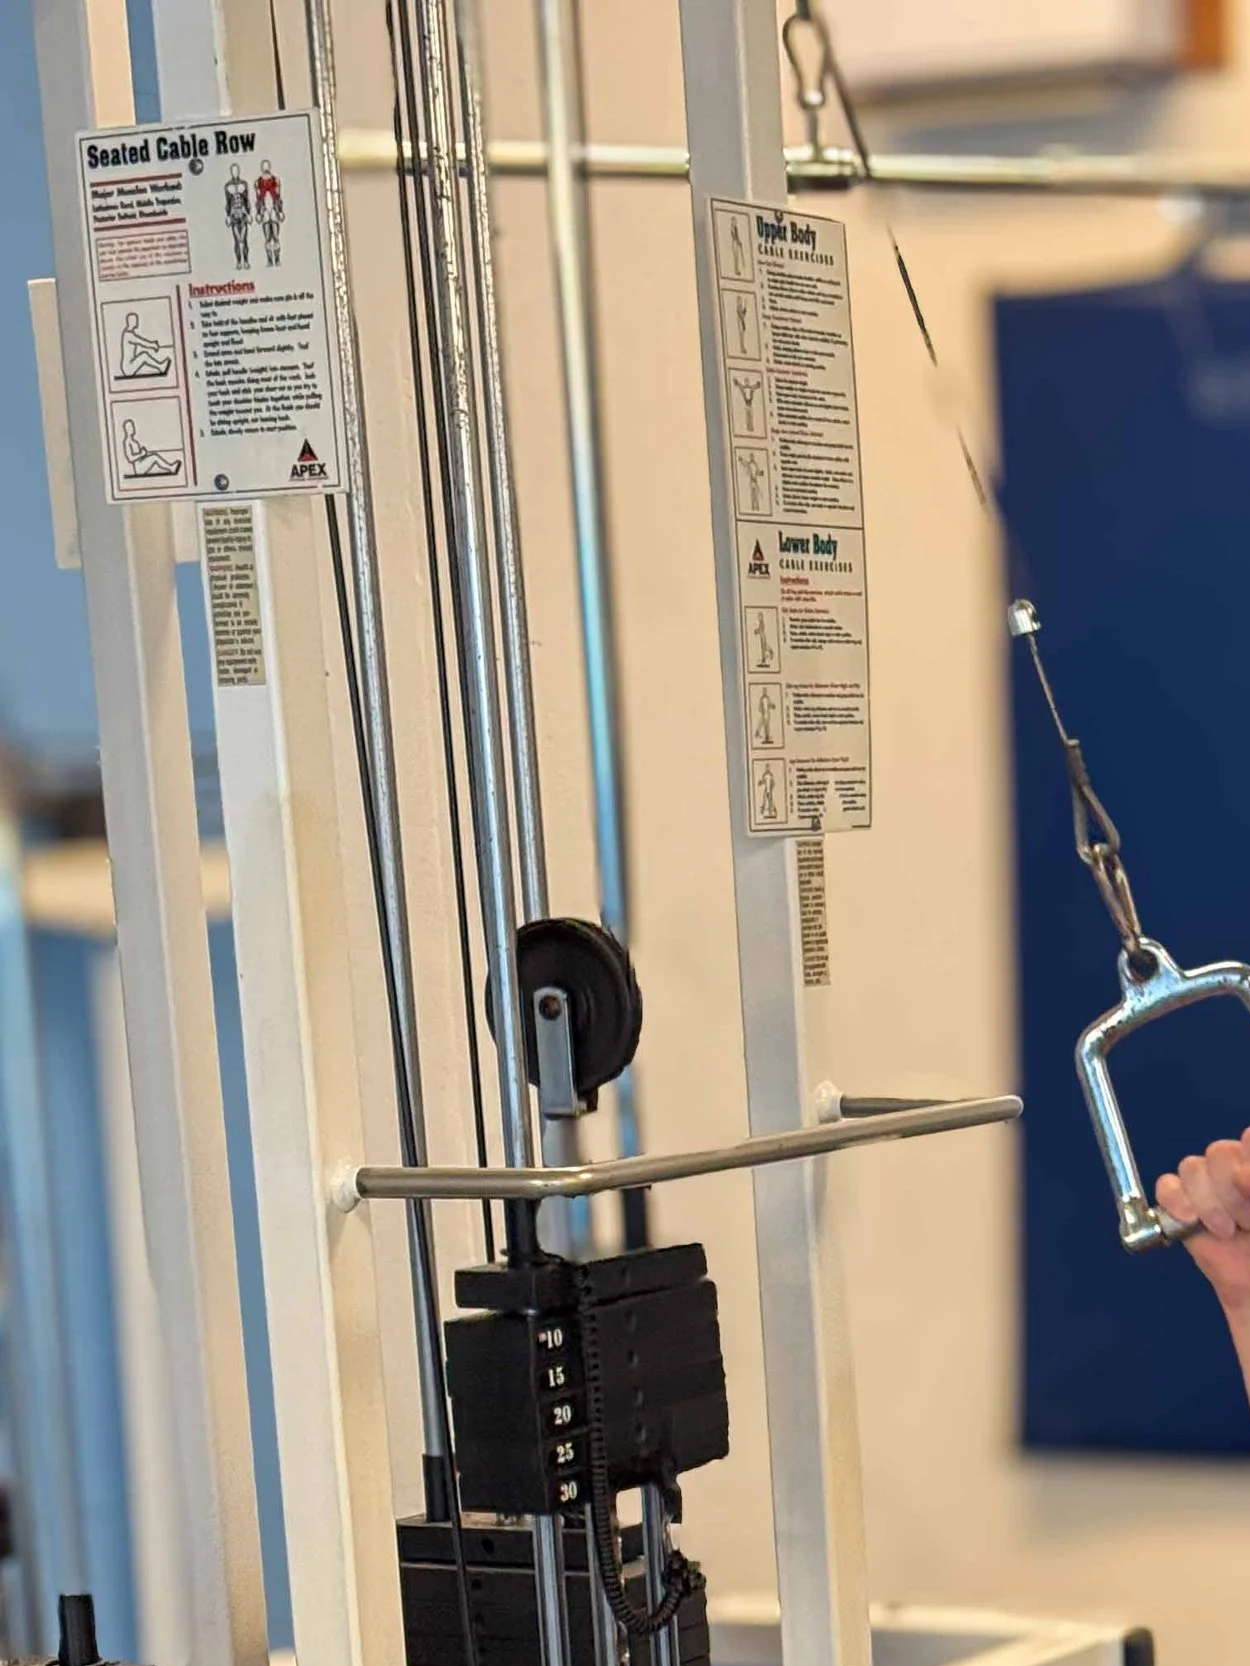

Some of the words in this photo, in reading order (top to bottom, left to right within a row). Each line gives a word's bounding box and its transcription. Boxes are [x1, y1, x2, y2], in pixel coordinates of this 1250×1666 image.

[87, 139, 151, 169] Seated
[156, 133, 209, 161] Cable
[215, 131, 256, 155] Row
[756, 216, 789, 245] Upper
[791, 221, 817, 252] Body
[758, 244, 785, 259] CABLE
[788, 249, 834, 266] EXERCISES
[189, 280, 256, 297] Instructions
[290, 463, 328, 478] APEX
[777, 530, 810, 554] Lower
[812, 532, 838, 560] Body
[748, 562, 770, 577] APEX
[779, 559, 805, 572] CABLE
[808, 561, 853, 574] EXERCISES
[548, 1366, 565, 1387] 15
[554, 1405, 572, 1425] 20
[556, 1442, 574, 1463] 25
[560, 1481, 577, 1502] 30
